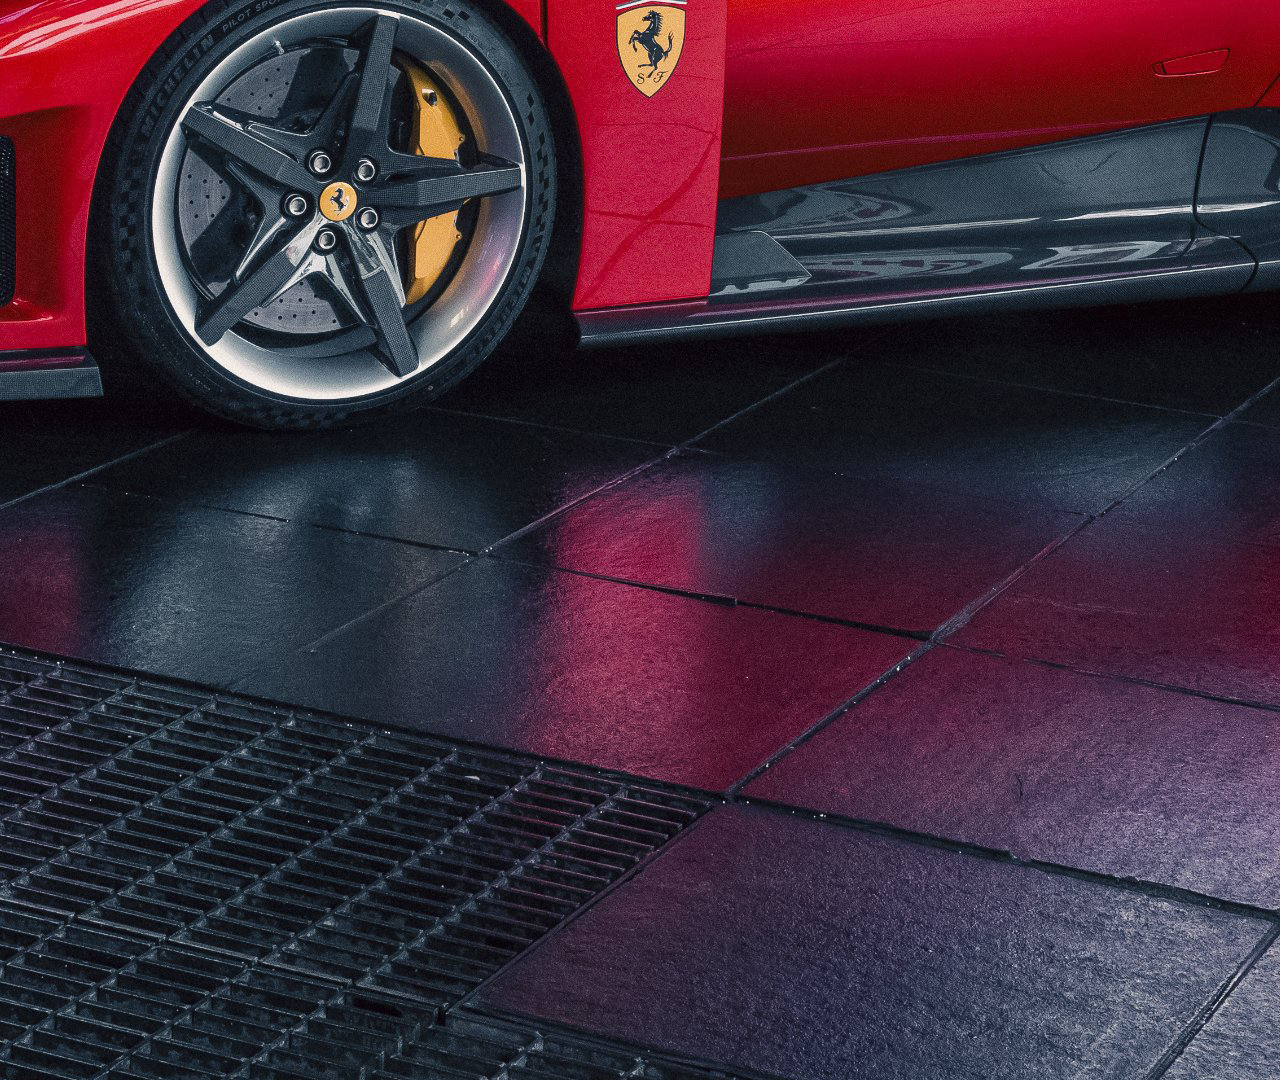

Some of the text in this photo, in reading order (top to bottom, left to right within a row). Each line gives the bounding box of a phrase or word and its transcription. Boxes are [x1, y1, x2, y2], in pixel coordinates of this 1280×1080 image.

[138, 33, 215, 137] MICHELIN
[222, 9, 251, 34] PILOT
[637, 72, 645, 84] S
